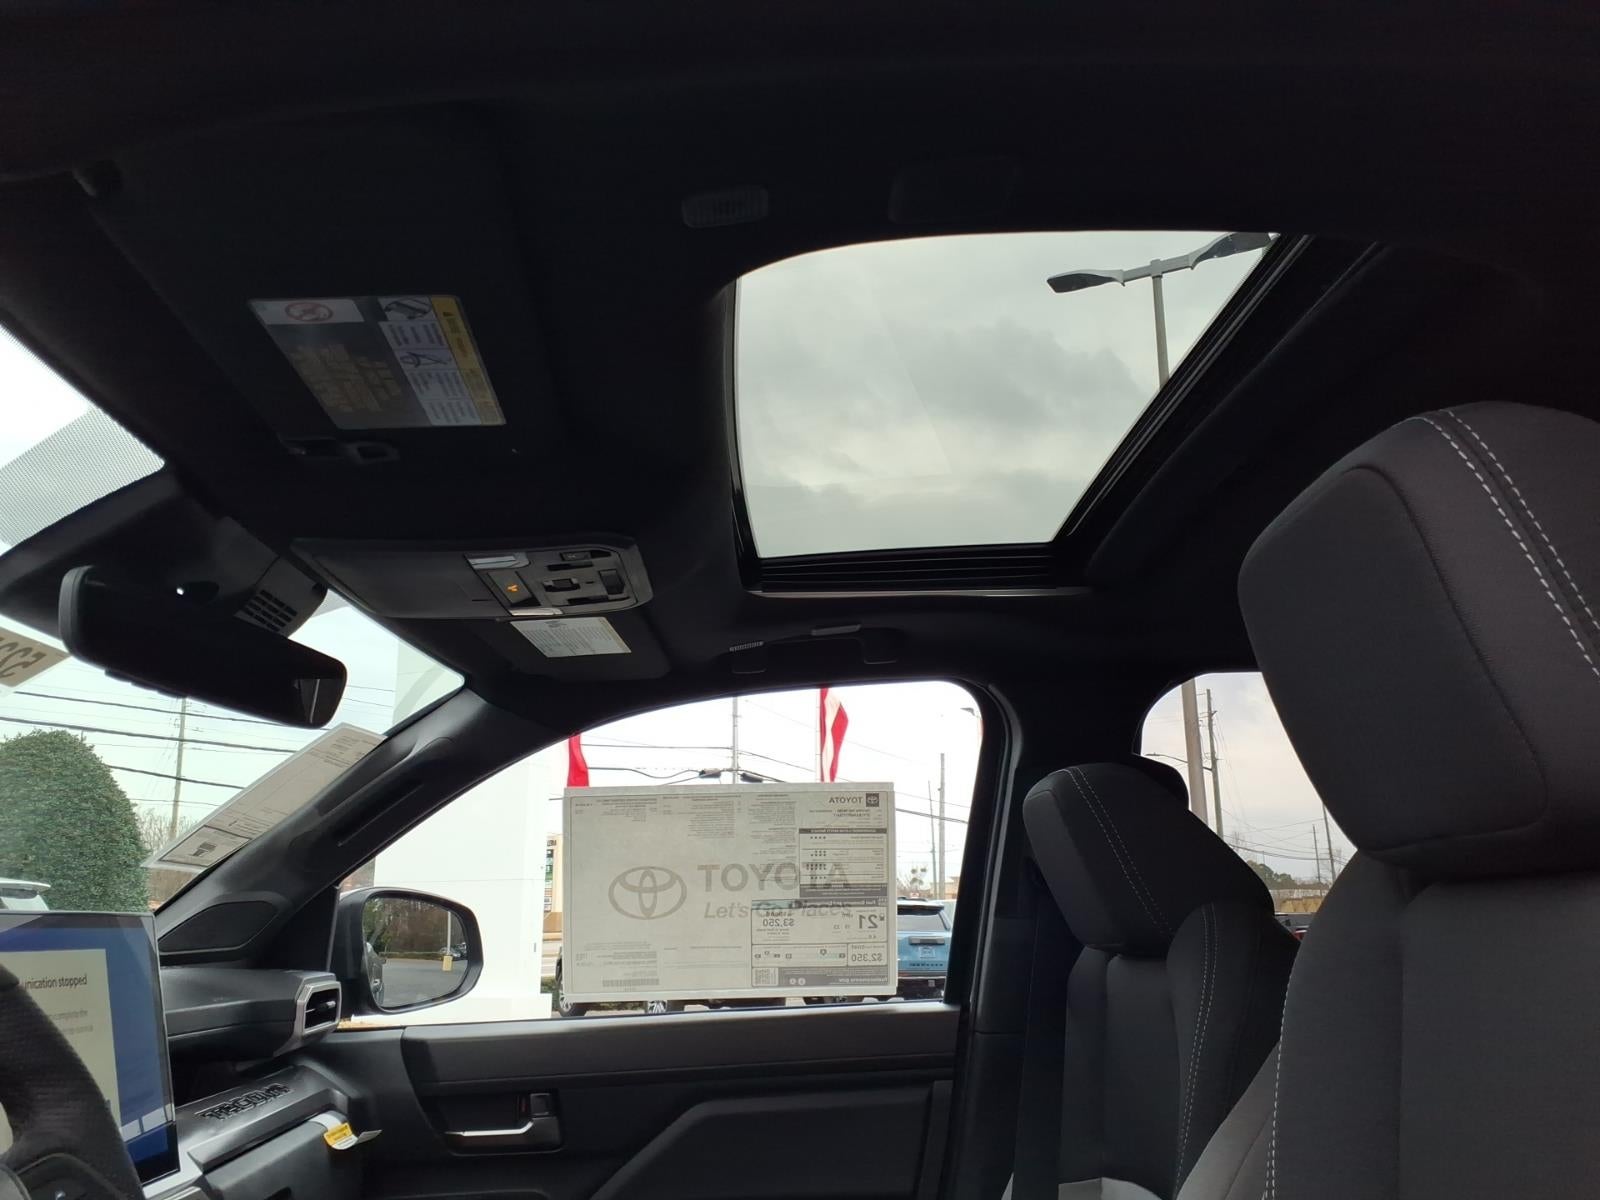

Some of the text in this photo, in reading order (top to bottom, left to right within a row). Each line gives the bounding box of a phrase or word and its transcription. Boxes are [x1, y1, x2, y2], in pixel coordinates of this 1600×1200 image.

[697, 861, 850, 893] TOYOTA
[704, 901, 748, 919] Let's
[59, 972, 88, 991] stopped
